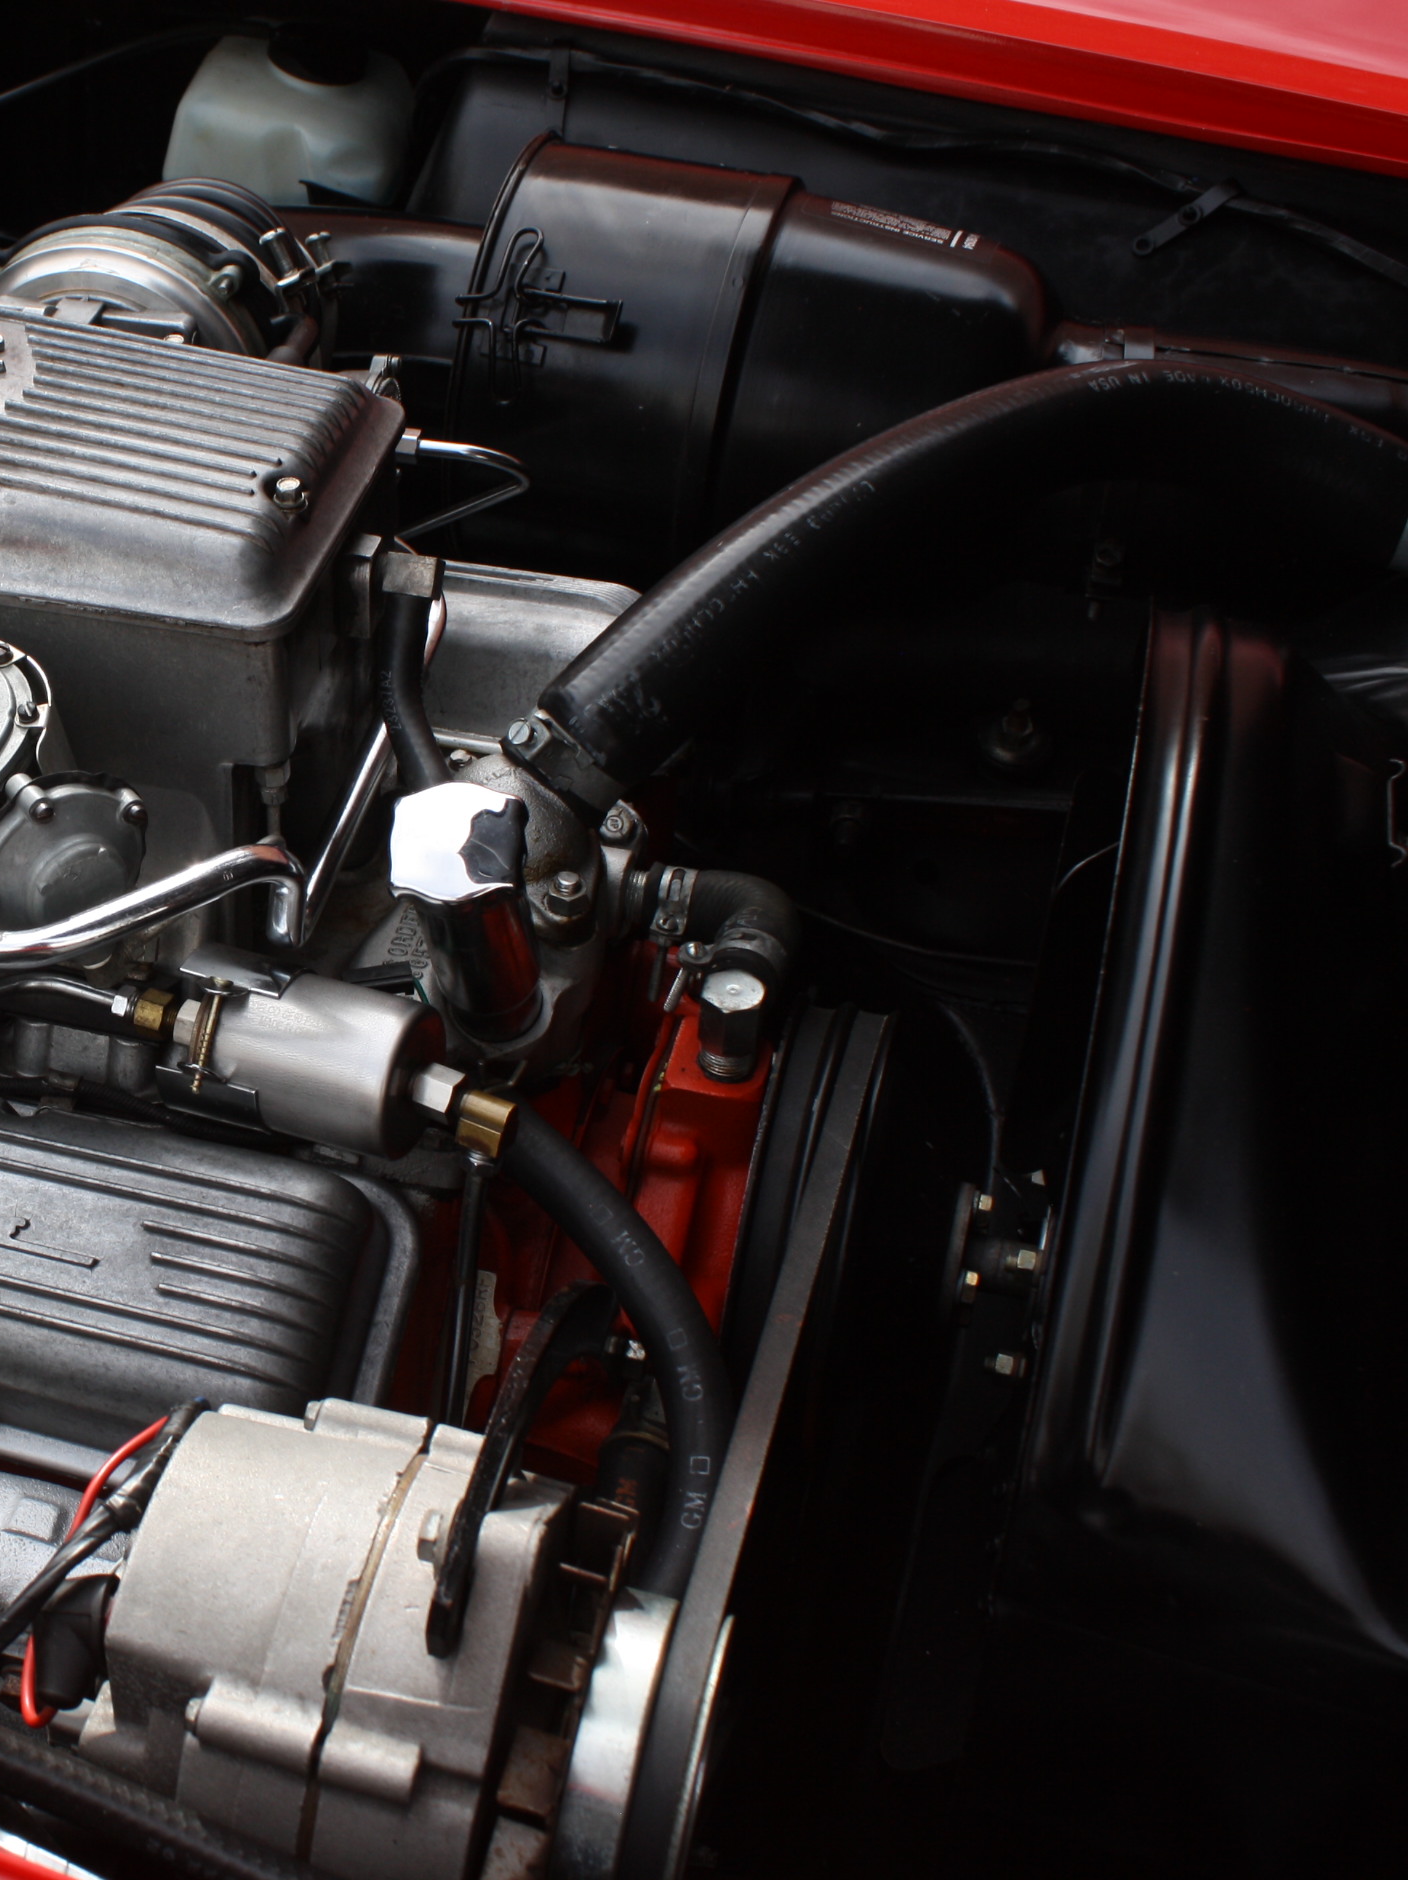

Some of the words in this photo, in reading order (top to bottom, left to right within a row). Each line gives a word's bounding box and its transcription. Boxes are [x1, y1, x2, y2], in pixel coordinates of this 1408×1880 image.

[831, 211, 901, 233] INSTRUCTIONS
[903, 231, 944, 245] SERVICE
[1087, 374, 1122, 392] USA
[1127, 371, 1151, 385] IN
[676, 1364, 704, 1402] GM
[680, 1492, 707, 1531] GM
